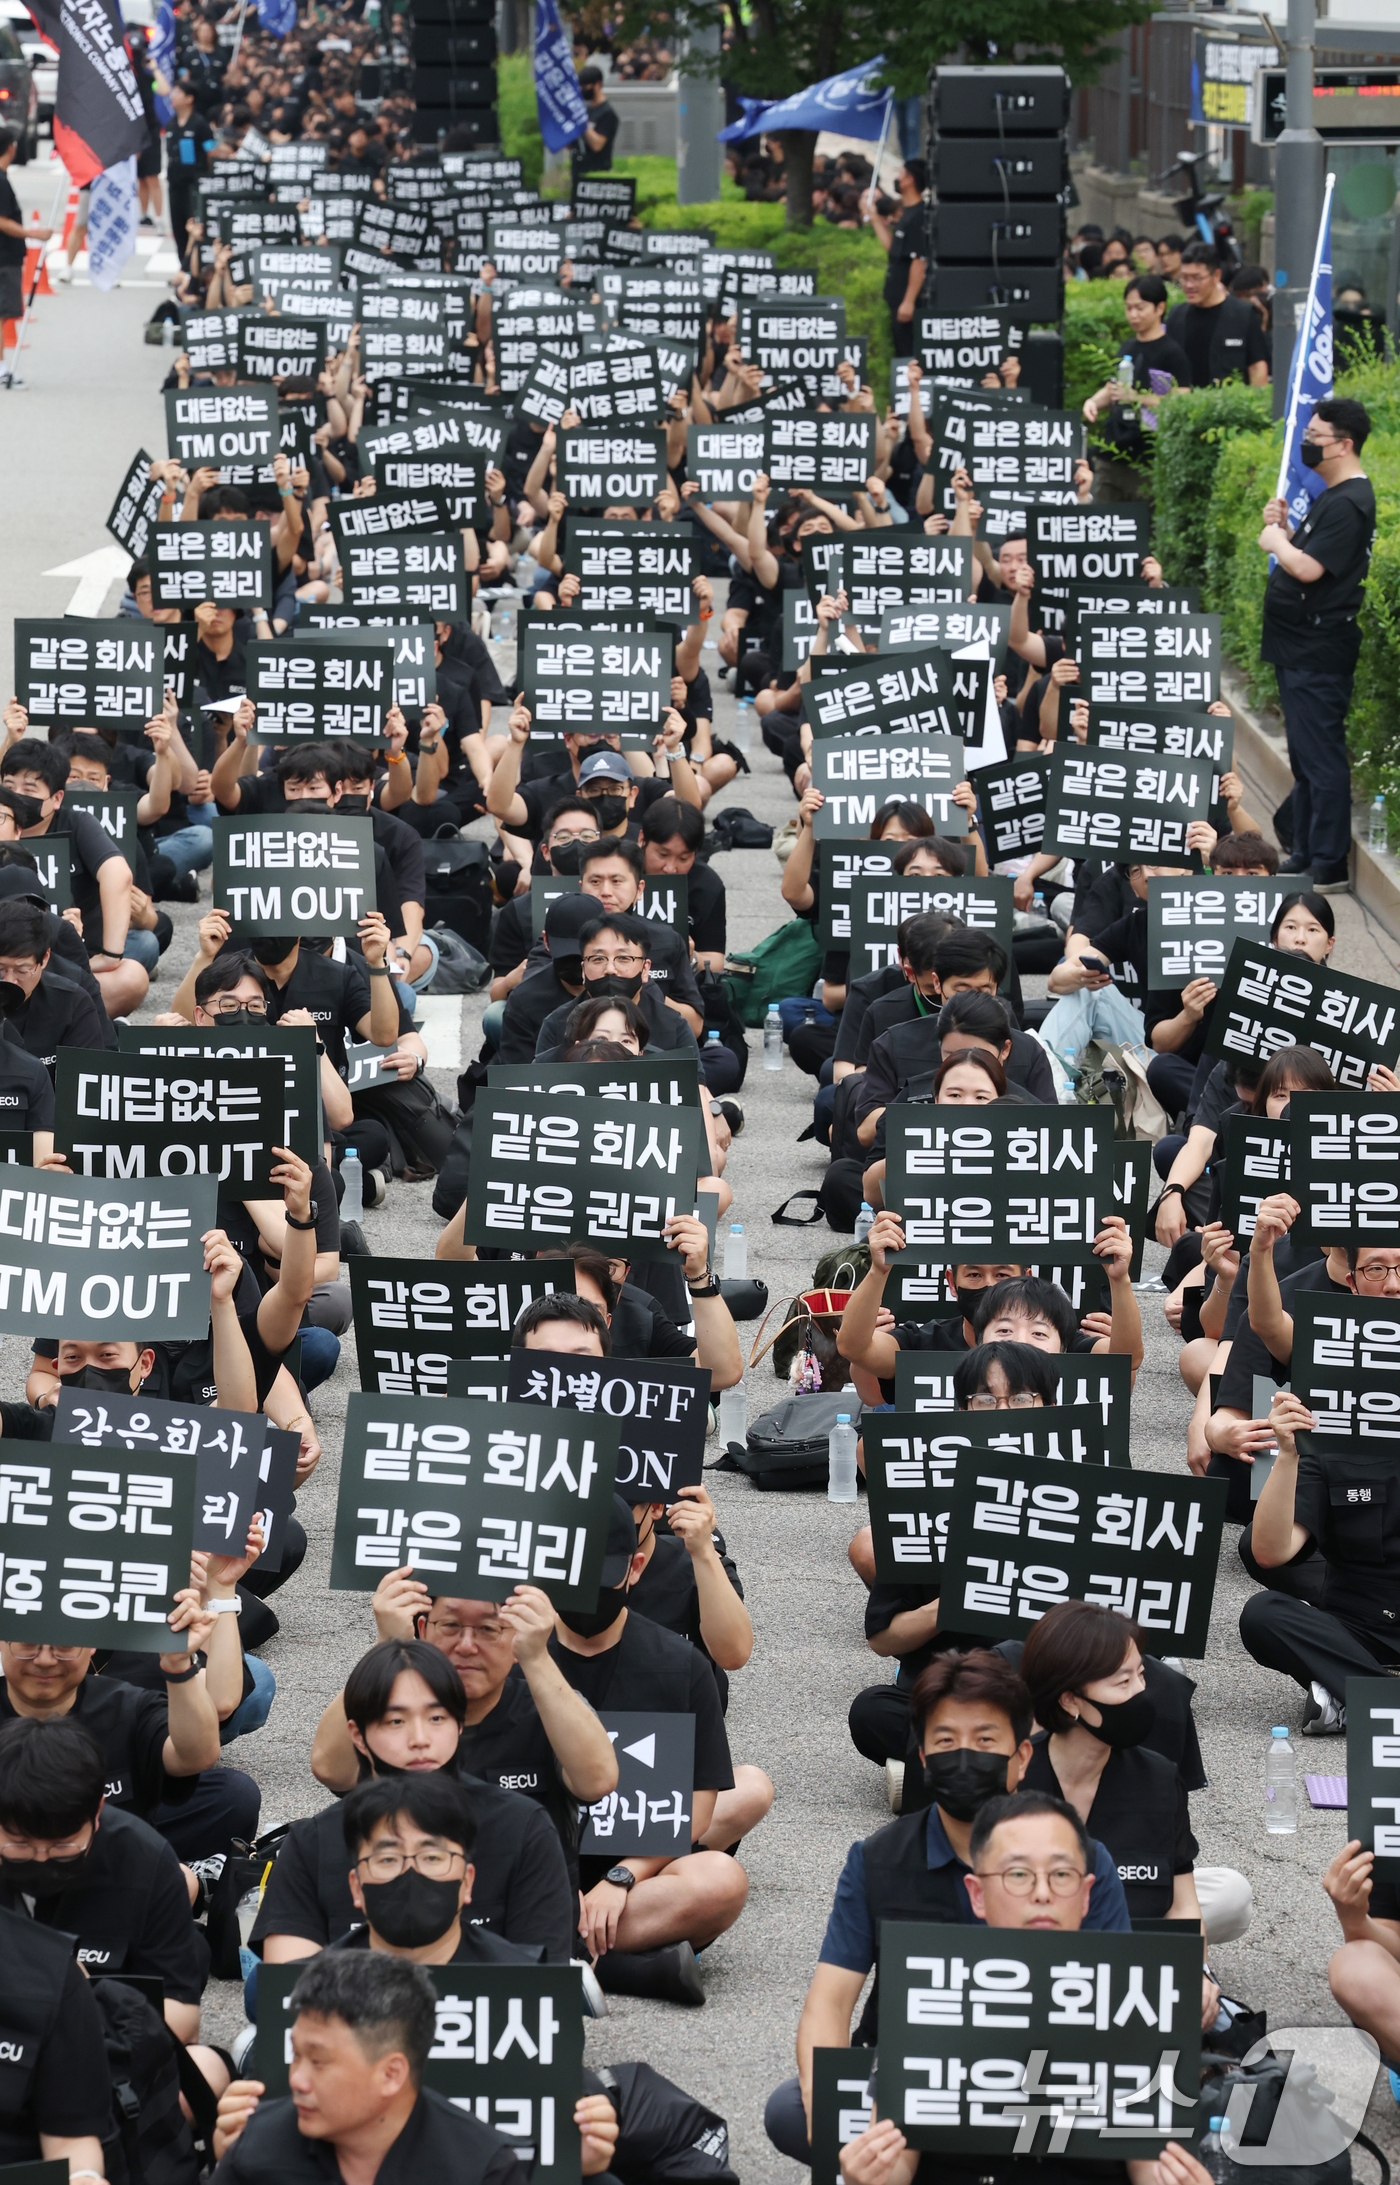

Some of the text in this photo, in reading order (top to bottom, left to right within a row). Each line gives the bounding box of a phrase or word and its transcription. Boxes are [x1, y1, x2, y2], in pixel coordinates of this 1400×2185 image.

[232, 214, 262, 234] 같은
[494, 229, 560, 250] 대답없는
[260, 252, 332, 274] 대답없는
[494, 255, 561, 274] TM OUT
[742, 273, 778, 294] 같은
[281, 293, 354, 317] 대답없는
[362, 296, 439, 322] 같은 회사
[186, 316, 226, 340] 같은
[245, 327, 318, 350] 대답없는
[537, 315, 574, 336] 회사
[757, 317, 838, 340] 대답없는
[922, 316, 1001, 340] 대답없는
[187, 344, 226, 368] 같은
[365, 334, 445, 356] 같은 회사
[500, 342, 538, 363] 같은
[757, 347, 839, 368] TM OUT
[921, 345, 1003, 369] TM OUT
[243, 355, 316, 377] TM OUT
[176, 396, 268, 424] 대답없는
[177, 431, 272, 458] TM OUT
[413, 419, 459, 452] 회사
[697, 434, 764, 458] 대답없
[771, 420, 869, 448] 같은 회사
[973, 421, 1020, 447] 같은
[1025, 421, 1073, 447] 회사
[566, 439, 657, 464] 대답없는
[385, 463, 475, 488] 대답없는
[696, 469, 734, 493] TM
[769, 456, 867, 483] 같은 권리
[973, 457, 1020, 483] 같은
[1024, 457, 1072, 483] 권리
[565, 474, 658, 498] TM OUT
[339, 499, 438, 536] 대답없는
[1037, 515, 1137, 543] 대답없는
[156, 531, 263, 561] 같은 회사
[350, 545, 457, 576] 같은 회사
[581, 547, 691, 575] 같은 회사
[852, 546, 904, 575] 같은
[909, 547, 963, 577] 회사
[1036, 553, 1138, 578] TM OUT
[158, 570, 262, 599] 같은 권리
[581, 586, 691, 615] 같은 권리
[852, 586, 904, 615] 같은
[888, 613, 1000, 645] 같은 회사
[1091, 626, 1211, 658] 같은 회사
[30, 637, 155, 673] 같은 회사
[536, 644, 662, 678] 같은 회사
[258, 657, 383, 692] 같은 회사
[1090, 670, 1211, 702] 같은 권리
[28, 682, 154, 718] 같은 권리
[535, 689, 660, 722] 같은 권리
[814, 663, 939, 724] 같은 회사
[257, 702, 381, 736] 같은 권리
[1099, 719, 1224, 761] 같은 회사
[827, 747, 951, 781] 대답없는
[987, 772, 1041, 811] 같은
[1062, 759, 1199, 807] 같은 회사
[825, 795, 876, 825] TM
[1057, 809, 1192, 855] 같은 권리
[229, 832, 360, 869] 대답없는
[227, 887, 364, 921] TM OUT
[1160, 891, 1224, 925] 같은
[1160, 940, 1225, 975] 같은
[1237, 960, 1396, 1045] 같은 회사
[1222, 1012, 1297, 1060] 같은
[0, 1096, 19, 1107] ECU
[77, 1073, 261, 1122] 대답없는
[491, 1112, 682, 1174] 같은 회사
[904, 1127, 1098, 1175] 같은 회사
[1310, 1114, 1400, 1161] 같은
[73, 1143, 263, 1181] TM OUT
[0, 1189, 191, 1250] 대답없는
[485, 1182, 677, 1240] 같은 권리
[1310, 1182, 1400, 1228] 같은
[903, 1197, 1095, 1245] 같은 권리
[80, 1273, 190, 1319] OUT
[368, 1280, 453, 1332] 같은
[1313, 1317, 1400, 1369] 같은
[364, 1421, 597, 1499] 같은 회사
[1346, 1488, 1373, 1503] 동행
[973, 1476, 1204, 1557] 같은 회사
[355, 1508, 588, 1586] 같은 권리
[964, 1556, 1070, 1620] 같은
[499, 1774, 538, 1790] SECU
[1118, 1864, 1158, 1882] SECU
[76, 1948, 106, 1963] ECU
[905, 1956, 1180, 2034] 같은 회사
[428, 1995, 559, 2064] 회사
[903, 2056, 1031, 2129] 같은
[1046, 2059, 1175, 2133] 권리
